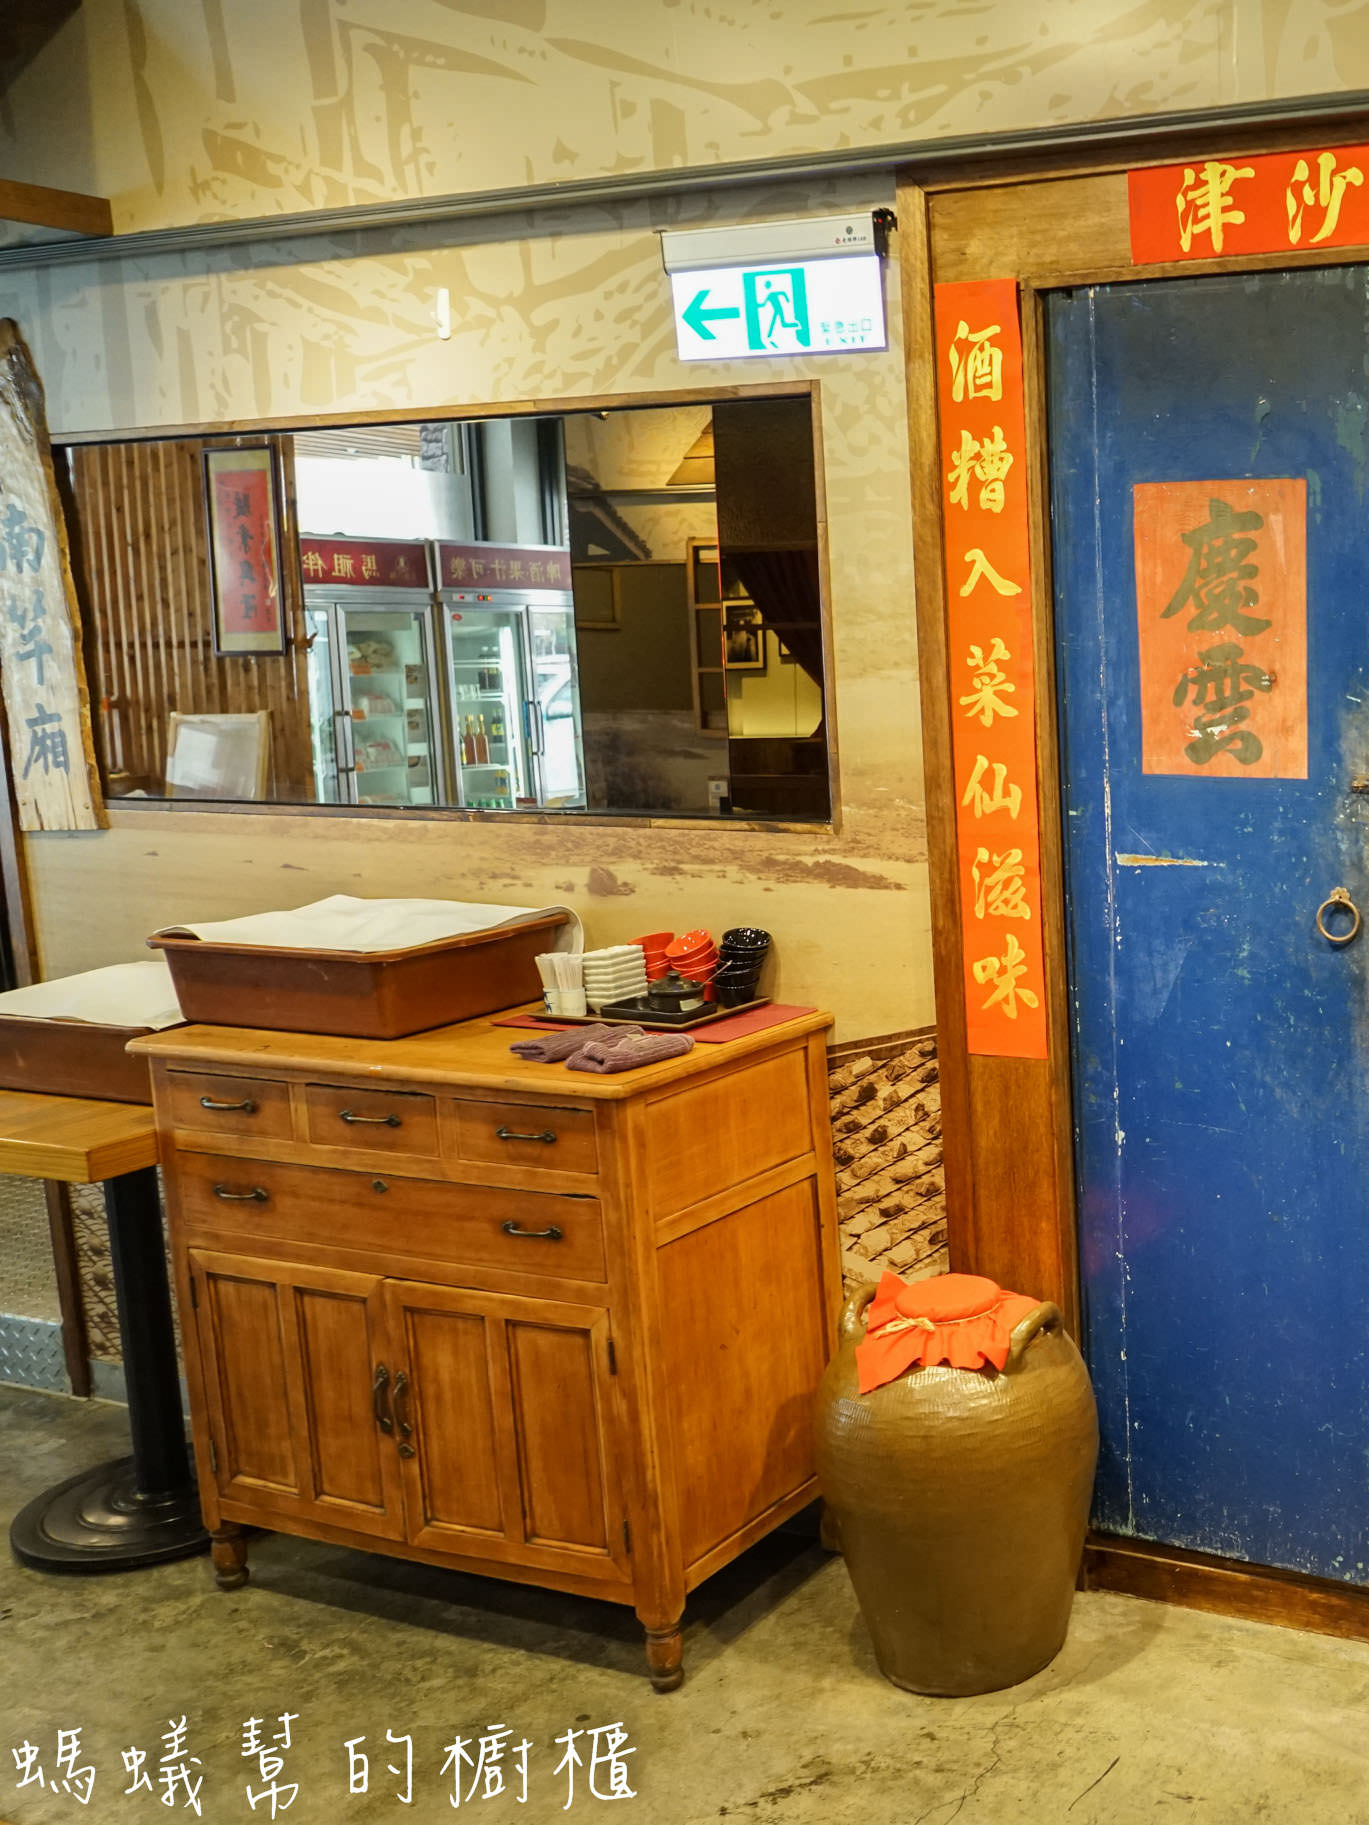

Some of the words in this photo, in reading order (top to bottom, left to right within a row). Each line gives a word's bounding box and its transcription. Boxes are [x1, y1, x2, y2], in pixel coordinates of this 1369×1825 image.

[947, 320, 1039, 1020] 酒糟入菜仙滋味
[1160, 498, 1273, 765] 慶雲
